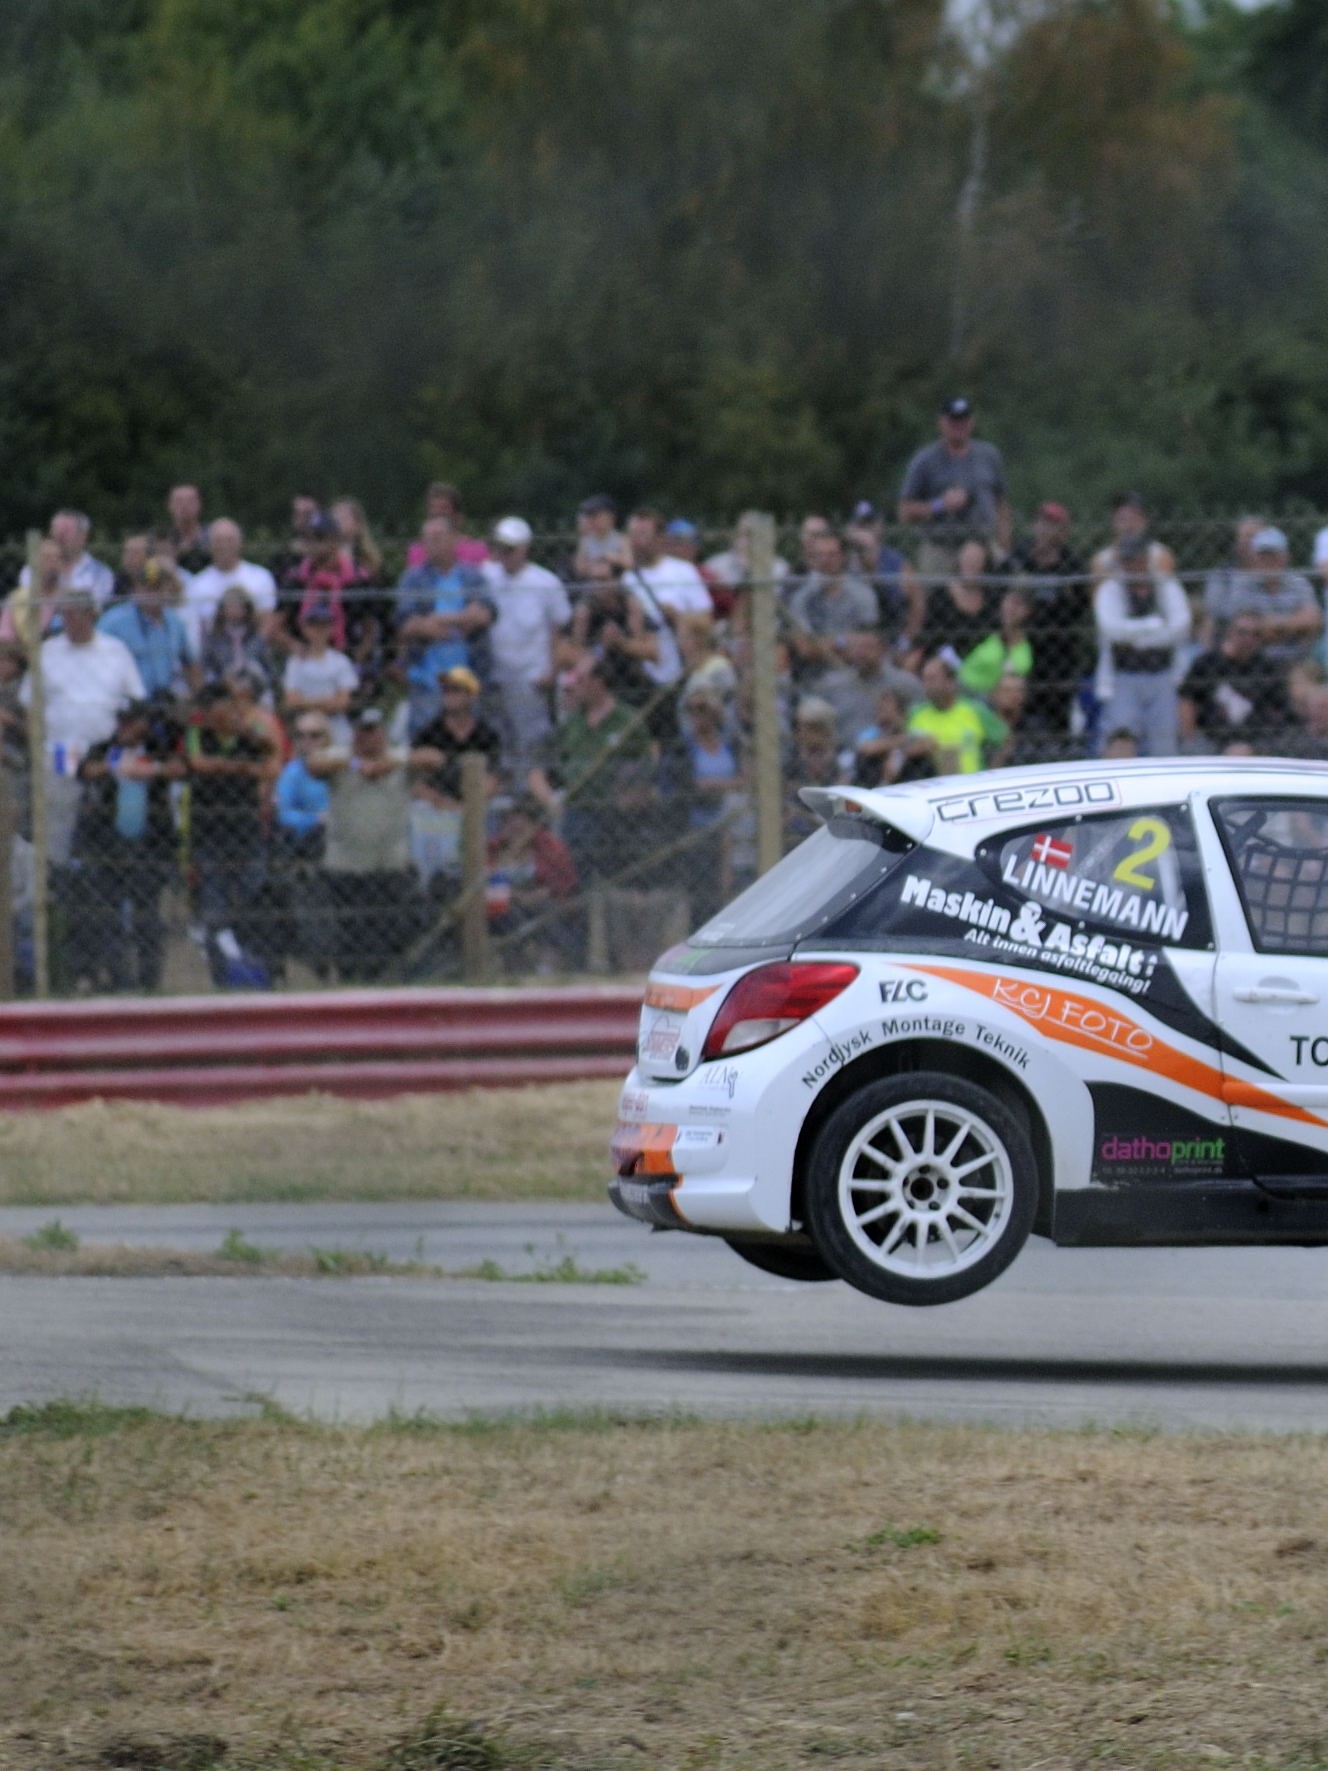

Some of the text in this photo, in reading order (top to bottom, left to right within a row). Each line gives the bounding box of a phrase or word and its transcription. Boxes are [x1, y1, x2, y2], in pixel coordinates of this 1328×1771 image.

[1113, 817, 1172, 890] 2
[901, 874, 1012, 935] Maskin
[1009, 900, 1046, 946] &
[1043, 922, 1144, 975] Asfalt
[1002, 854, 1189, 941] LINNEMANN
[964, 928, 990, 945] Alt
[992, 936, 1038, 959] innen
[802, 1016, 1030, 1089] Nordjysk Montage Teknik
[1061, 1000, 1153, 1050] FOTO
